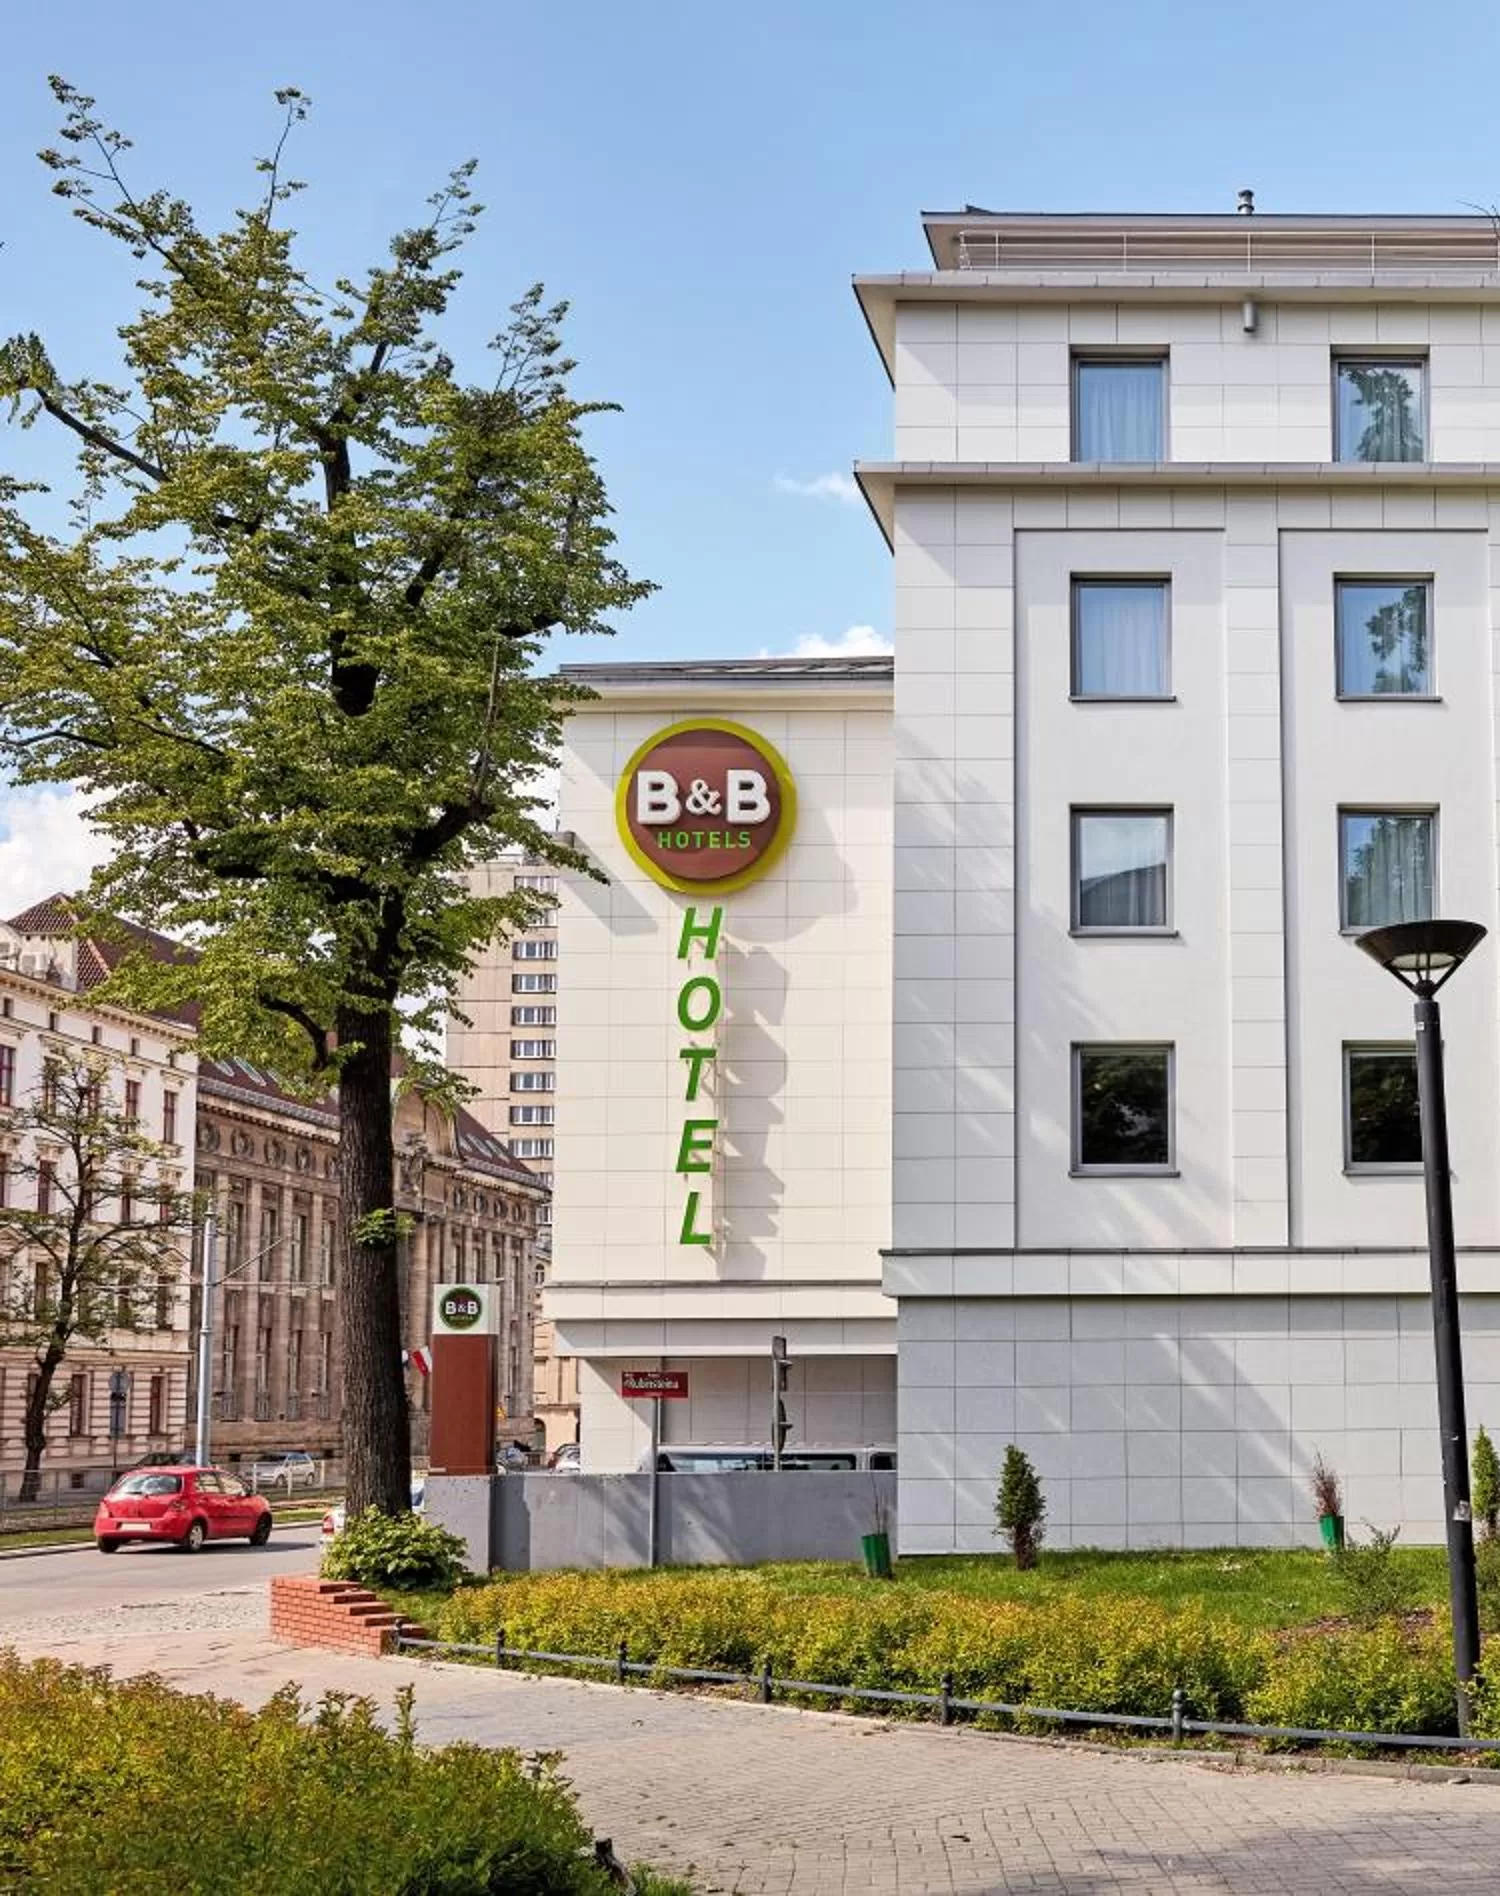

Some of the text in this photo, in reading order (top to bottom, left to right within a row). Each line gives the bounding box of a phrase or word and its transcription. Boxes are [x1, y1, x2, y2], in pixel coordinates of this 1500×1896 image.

[637, 769, 771, 824] B&B
[658, 831, 751, 849] HOTELS
[675, 906, 724, 1245] HOTEL
[445, 1301, 478, 1315] B&B
